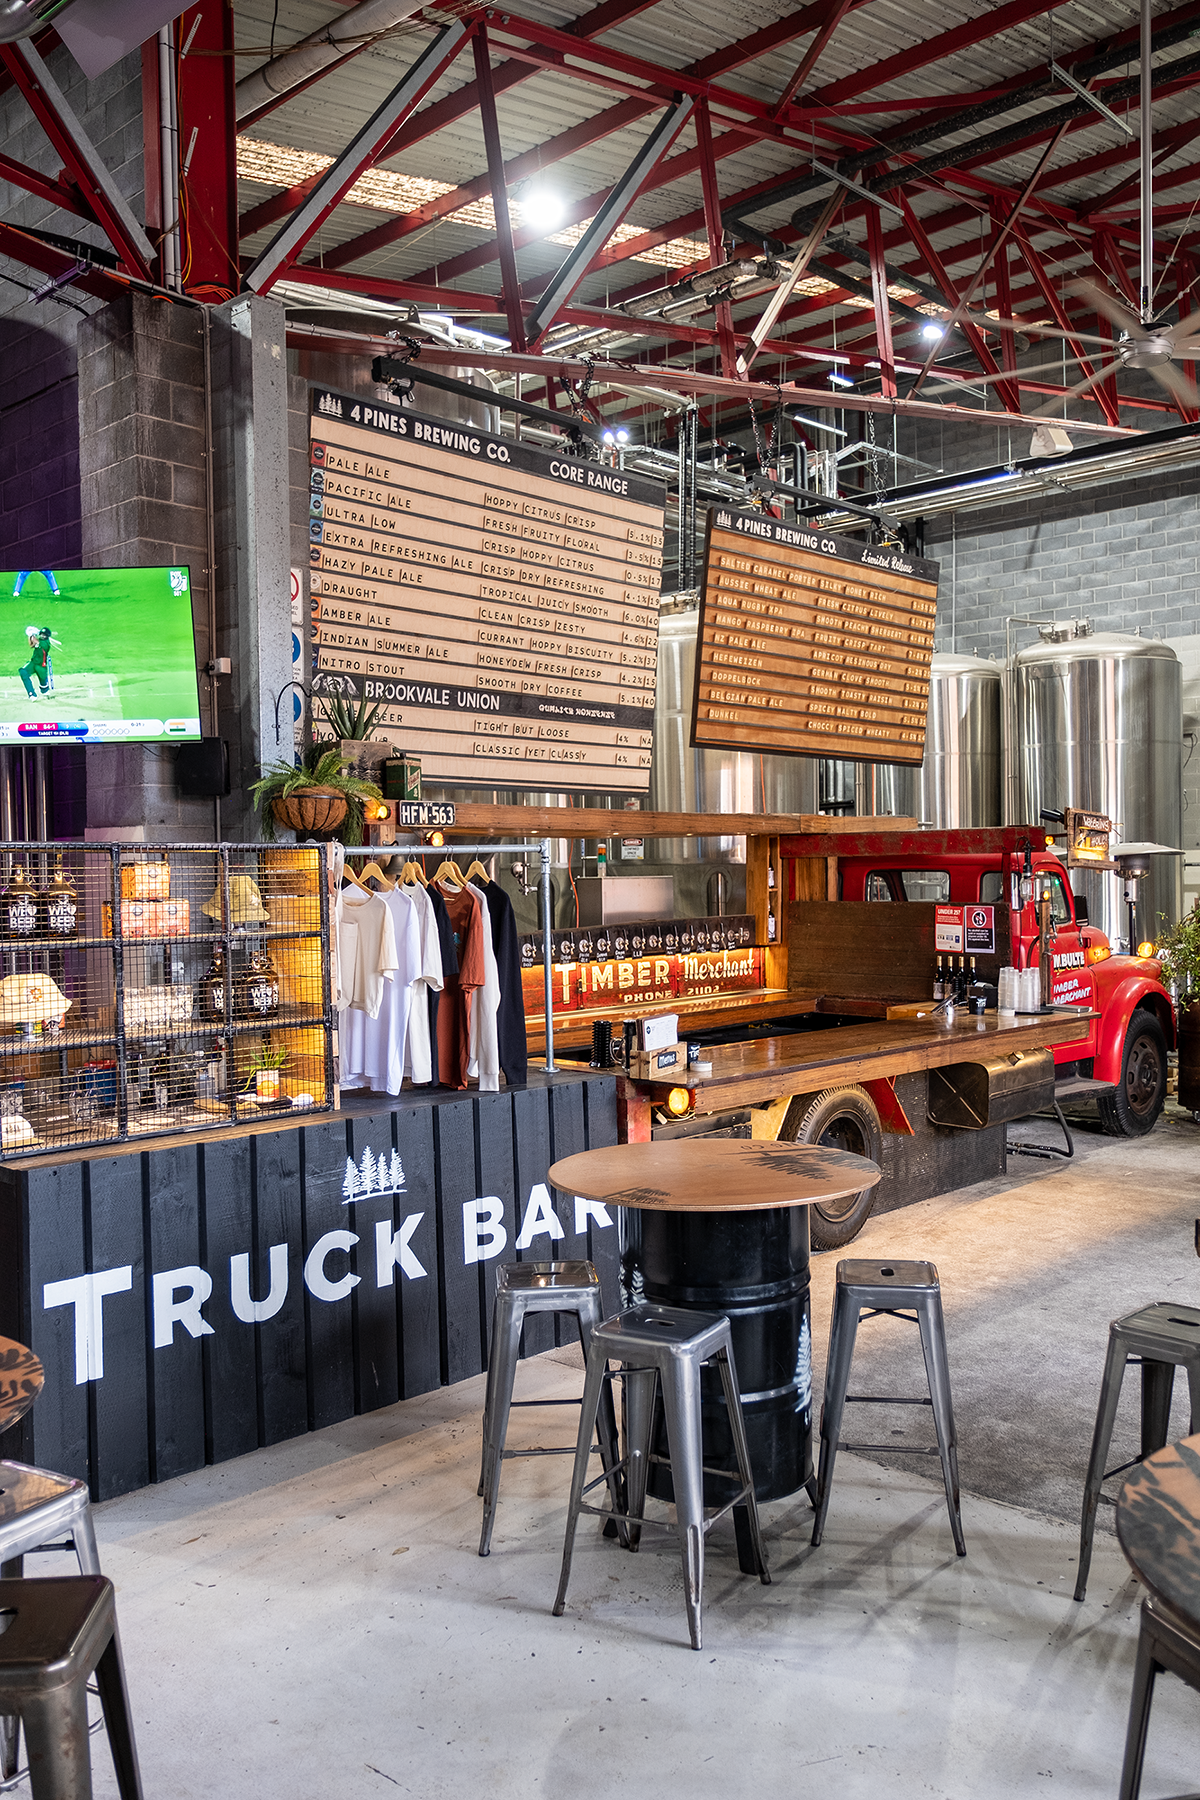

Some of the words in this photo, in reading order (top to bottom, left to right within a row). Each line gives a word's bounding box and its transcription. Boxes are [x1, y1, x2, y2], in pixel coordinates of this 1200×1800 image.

[350, 405, 361, 422] 4
[364, 408, 407, 435] PINES
[414, 422, 481, 454] BREWING
[487, 443, 511, 463] CO.
[329, 456, 359, 471] PALE
[368, 466, 390, 479] ALE
[549, 461, 584, 483] CORE
[587, 471, 628, 495] RANGE
[328, 481, 382, 502] PACIFIC
[390, 497, 411, 509] ALE
[327, 507, 365, 524] ULTRA
[374, 517, 396, 530] LOW
[486, 496, 518, 510] HOPPY
[525, 505, 561, 521] CITRUS
[567, 515, 596, 529] CRISP
[485, 518, 517, 533] FRESH
[524, 527, 560, 543] FRUITY
[566, 537, 600, 552] FLORAL
[736, 517, 743, 529] 4
[744, 518, 772, 538] PINES
[776, 527, 819, 550] BREWING
[821, 539, 837, 554] CO.
[326, 532, 364, 548] EXTRA
[374, 542, 447, 564] REFRESHING
[454, 558, 473, 570] ALE
[485, 541, 516, 555] CRISP
[523, 550, 553, 564] HOPPY
[560, 558, 594, 572] CITRUS
[325, 557, 356, 571] HAZY
[365, 565, 394, 578] PALE
[402, 571, 423, 584] ALE
[483, 564, 516, 577] CRISP
[521, 572, 541, 583] DRY
[546, 576, 605, 595] REFRESHING
[720, 557, 750, 571] SALTED
[753, 565, 786, 579] CARAMEL
[789, 573, 816, 585] PORTER
[324, 583, 377, 600] DRAUGHT
[719, 577, 749, 590] AUSSIE
[754, 583, 779, 596] WHEAT
[782, 591, 797, 600] ALE
[820, 580, 842, 591] SILKY
[845, 586, 867, 597] HONEY
[869, 591, 887, 601] RICH
[482, 586, 533, 603] TROPICAL
[540, 597, 570, 610] JUICY
[575, 604, 609, 617] SMOOTH
[717, 596, 738, 607] AQUA
[741, 600, 766, 612] RUGBY
[768, 605, 783, 615] XPA
[817, 597, 839, 608] FRESH
[842, 603, 867, 615] CITRUS
[870, 609, 894, 620] LIVELY
[323, 607, 361, 622] AMBER
[369, 614, 391, 626] ALE
[481, 610, 514, 622] CLEAN
[520, 616, 550, 628] CRISP
[557, 622, 586, 634] ZESTY
[716, 615, 742, 626] MANGO
[746, 620, 789, 635] RASPBERRY
[791, 628, 805, 638] IPA
[816, 615, 843, 627] SMOOTH
[844, 621, 870, 631] PEACHY
[323, 632, 369, 647] INDIAN
[377, 640, 421, 654] SUMMER
[428, 647, 449, 658] ALE
[480, 632, 525, 646] CURRANT
[532, 640, 562, 651] HOPPY
[568, 646, 614, 660] BISCUITY
[714, 634, 725, 643] NZ
[729, 636, 749, 647] PALE
[751, 641, 767, 649] ALE
[815, 633, 841, 644] FRUITY
[844, 638, 866, 649] CRISP
[870, 643, 886, 653] TART
[321, 658, 360, 670] NITRO
[369, 664, 405, 676] STOUT
[479, 654, 531, 669] HONEYDEW
[538, 663, 567, 674] FRESH
[573, 667, 602, 678] CRISP
[713, 653, 763, 668] HEFEWEIZEN
[813, 651, 844, 662] APRICOT
[879, 662, 892, 671] DRY
[478, 677, 516, 689] SMOOTH
[523, 683, 541, 692] DRY
[548, 686, 583, 697] COFFEE
[712, 672, 761, 686] DOPPELBOCK
[812, 668, 839, 679] GERMAN
[841, 673, 863, 683] CLOVE
[866, 677, 890, 686] SMOOTH
[365, 680, 450, 706] BROOKVALE
[457, 691, 500, 711] UNION
[711, 690, 746, 702] BELGIAN
[747, 695, 766, 705] PALE
[769, 699, 783, 707] ALE
[811, 686, 837, 695] SMOOTH
[841, 690, 866, 699] TOASTY
[374, 712, 403, 723] BEER
[709, 709, 739, 720] DUNKEL
[809, 703, 835, 714] SPICEY
[836, 707, 858, 717] MALTY
[860, 710, 877, 719] BOLD
[476, 722, 509, 731] TIGHT
[515, 725, 534, 734] BUT
[540, 728, 569, 738] LOOSE
[808, 721, 834, 731] CHOCCY
[838, 724, 863, 734] SPICED
[866, 728, 891, 738] WHEATY
[476, 744, 520, 756] CLASSIC
[527, 748, 546, 757] YET
[551, 750, 587, 760] CLASSY
[10, 917, 36, 929] BEER
[50, 916, 76, 928] BEER
[554, 960, 670, 1005] TIMBER
[677, 948, 755, 982] Merchant
[1053, 978, 1079, 994] IMBER
[623, 990, 673, 1003] PHONE
[42, 1211, 429, 1386] TRUCK
[462, 1182, 614, 1265] BAR
